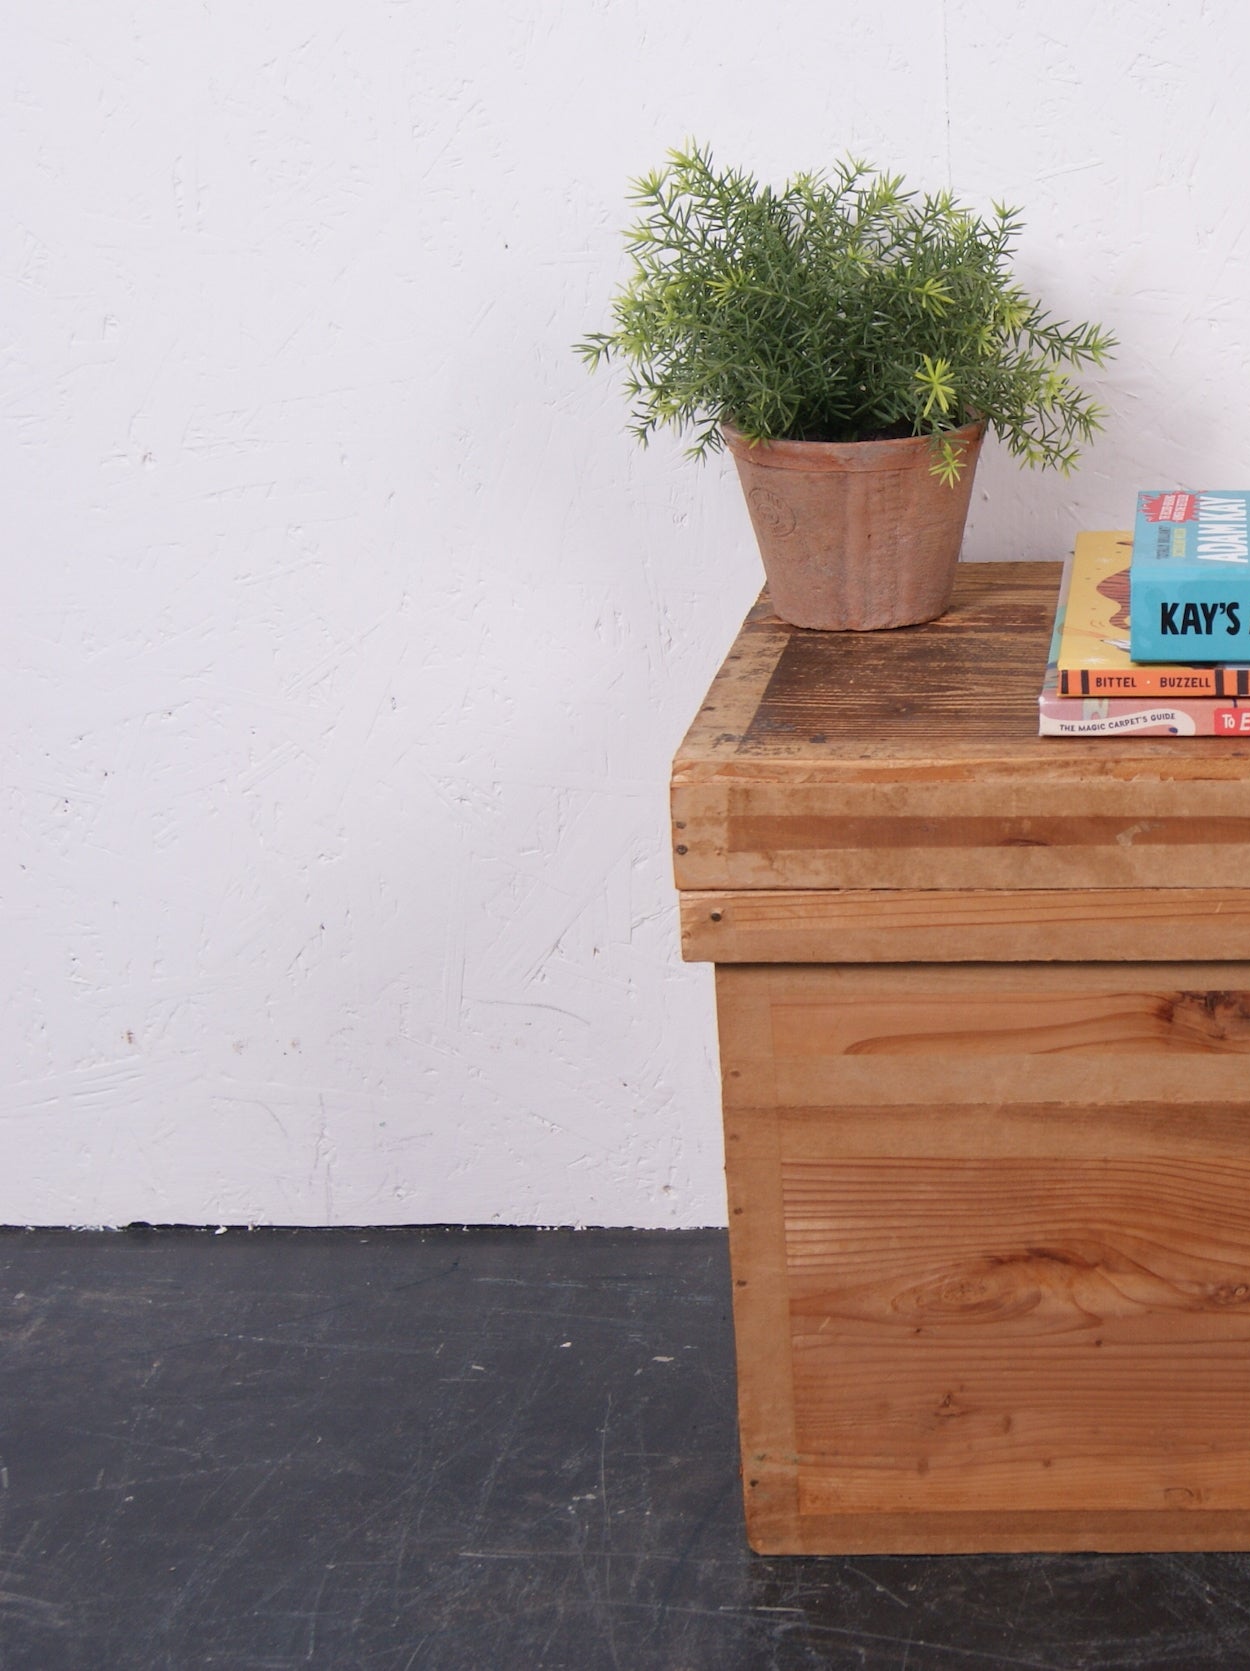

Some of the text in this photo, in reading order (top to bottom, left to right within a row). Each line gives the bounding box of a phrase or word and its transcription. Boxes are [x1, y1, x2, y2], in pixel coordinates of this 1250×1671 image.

[1196, 496, 1248, 563] ADAM KAY
[1160, 602, 1241, 635] KAY'S
[1096, 677, 1211, 688] BITTEL BUZZELL
[1060, 712, 1176, 732] THE MAGIC CARPET'S GUIDE
